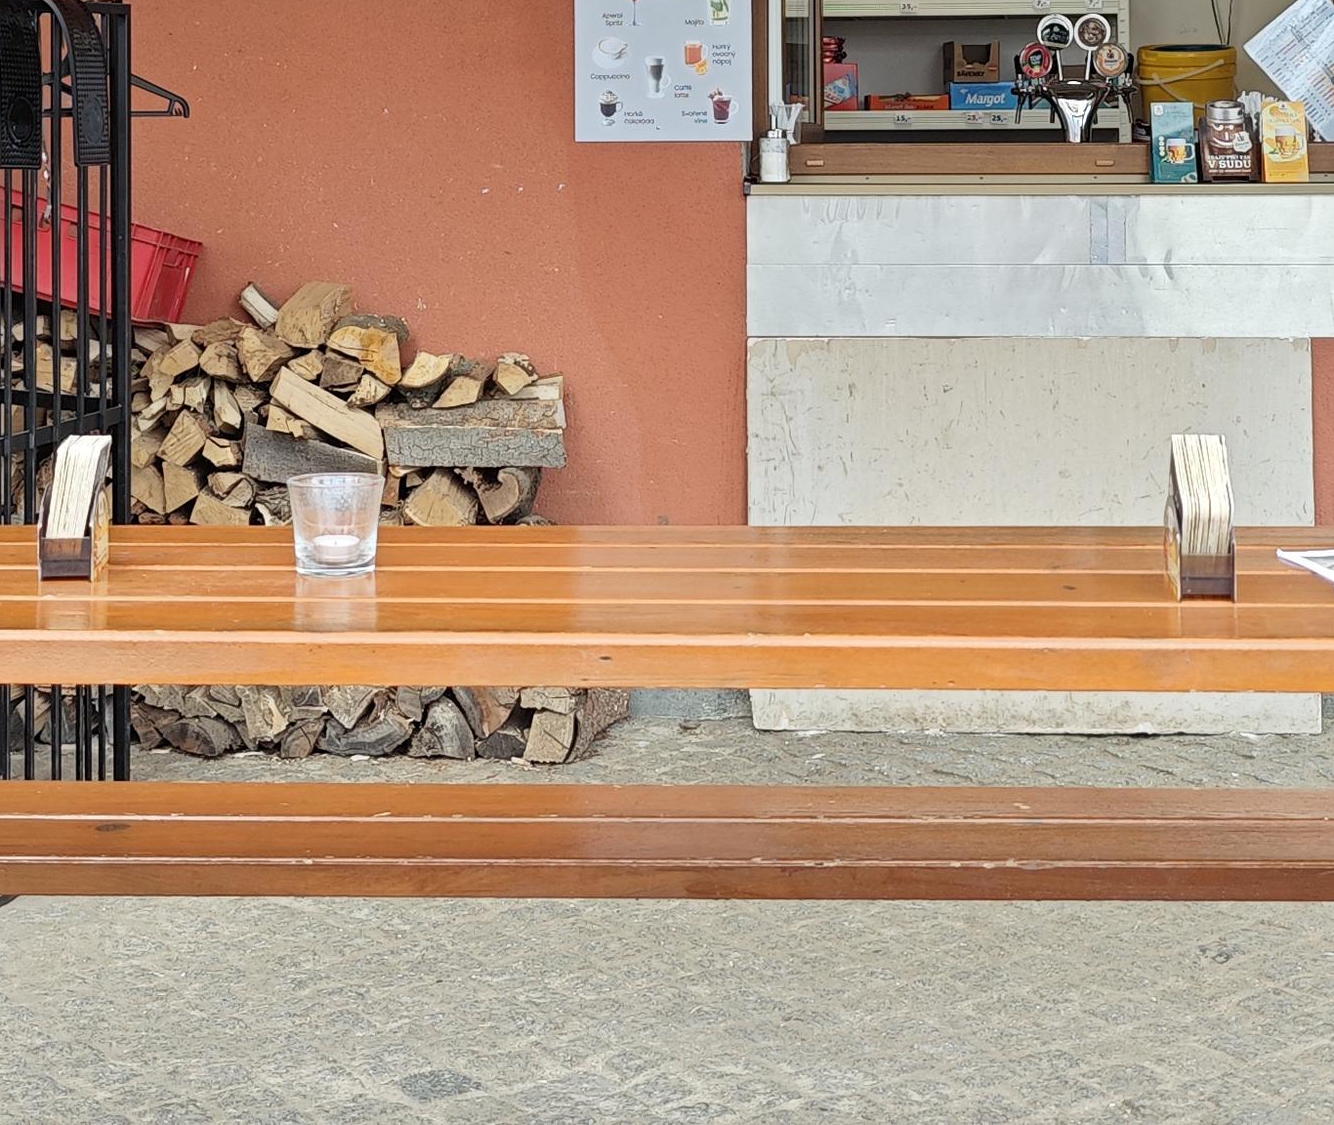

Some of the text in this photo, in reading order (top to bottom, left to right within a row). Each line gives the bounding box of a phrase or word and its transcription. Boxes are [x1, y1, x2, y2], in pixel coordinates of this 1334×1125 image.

[964, 93, 1006, 106] Margot
[1208, 160, 1251, 168] V SUDU
